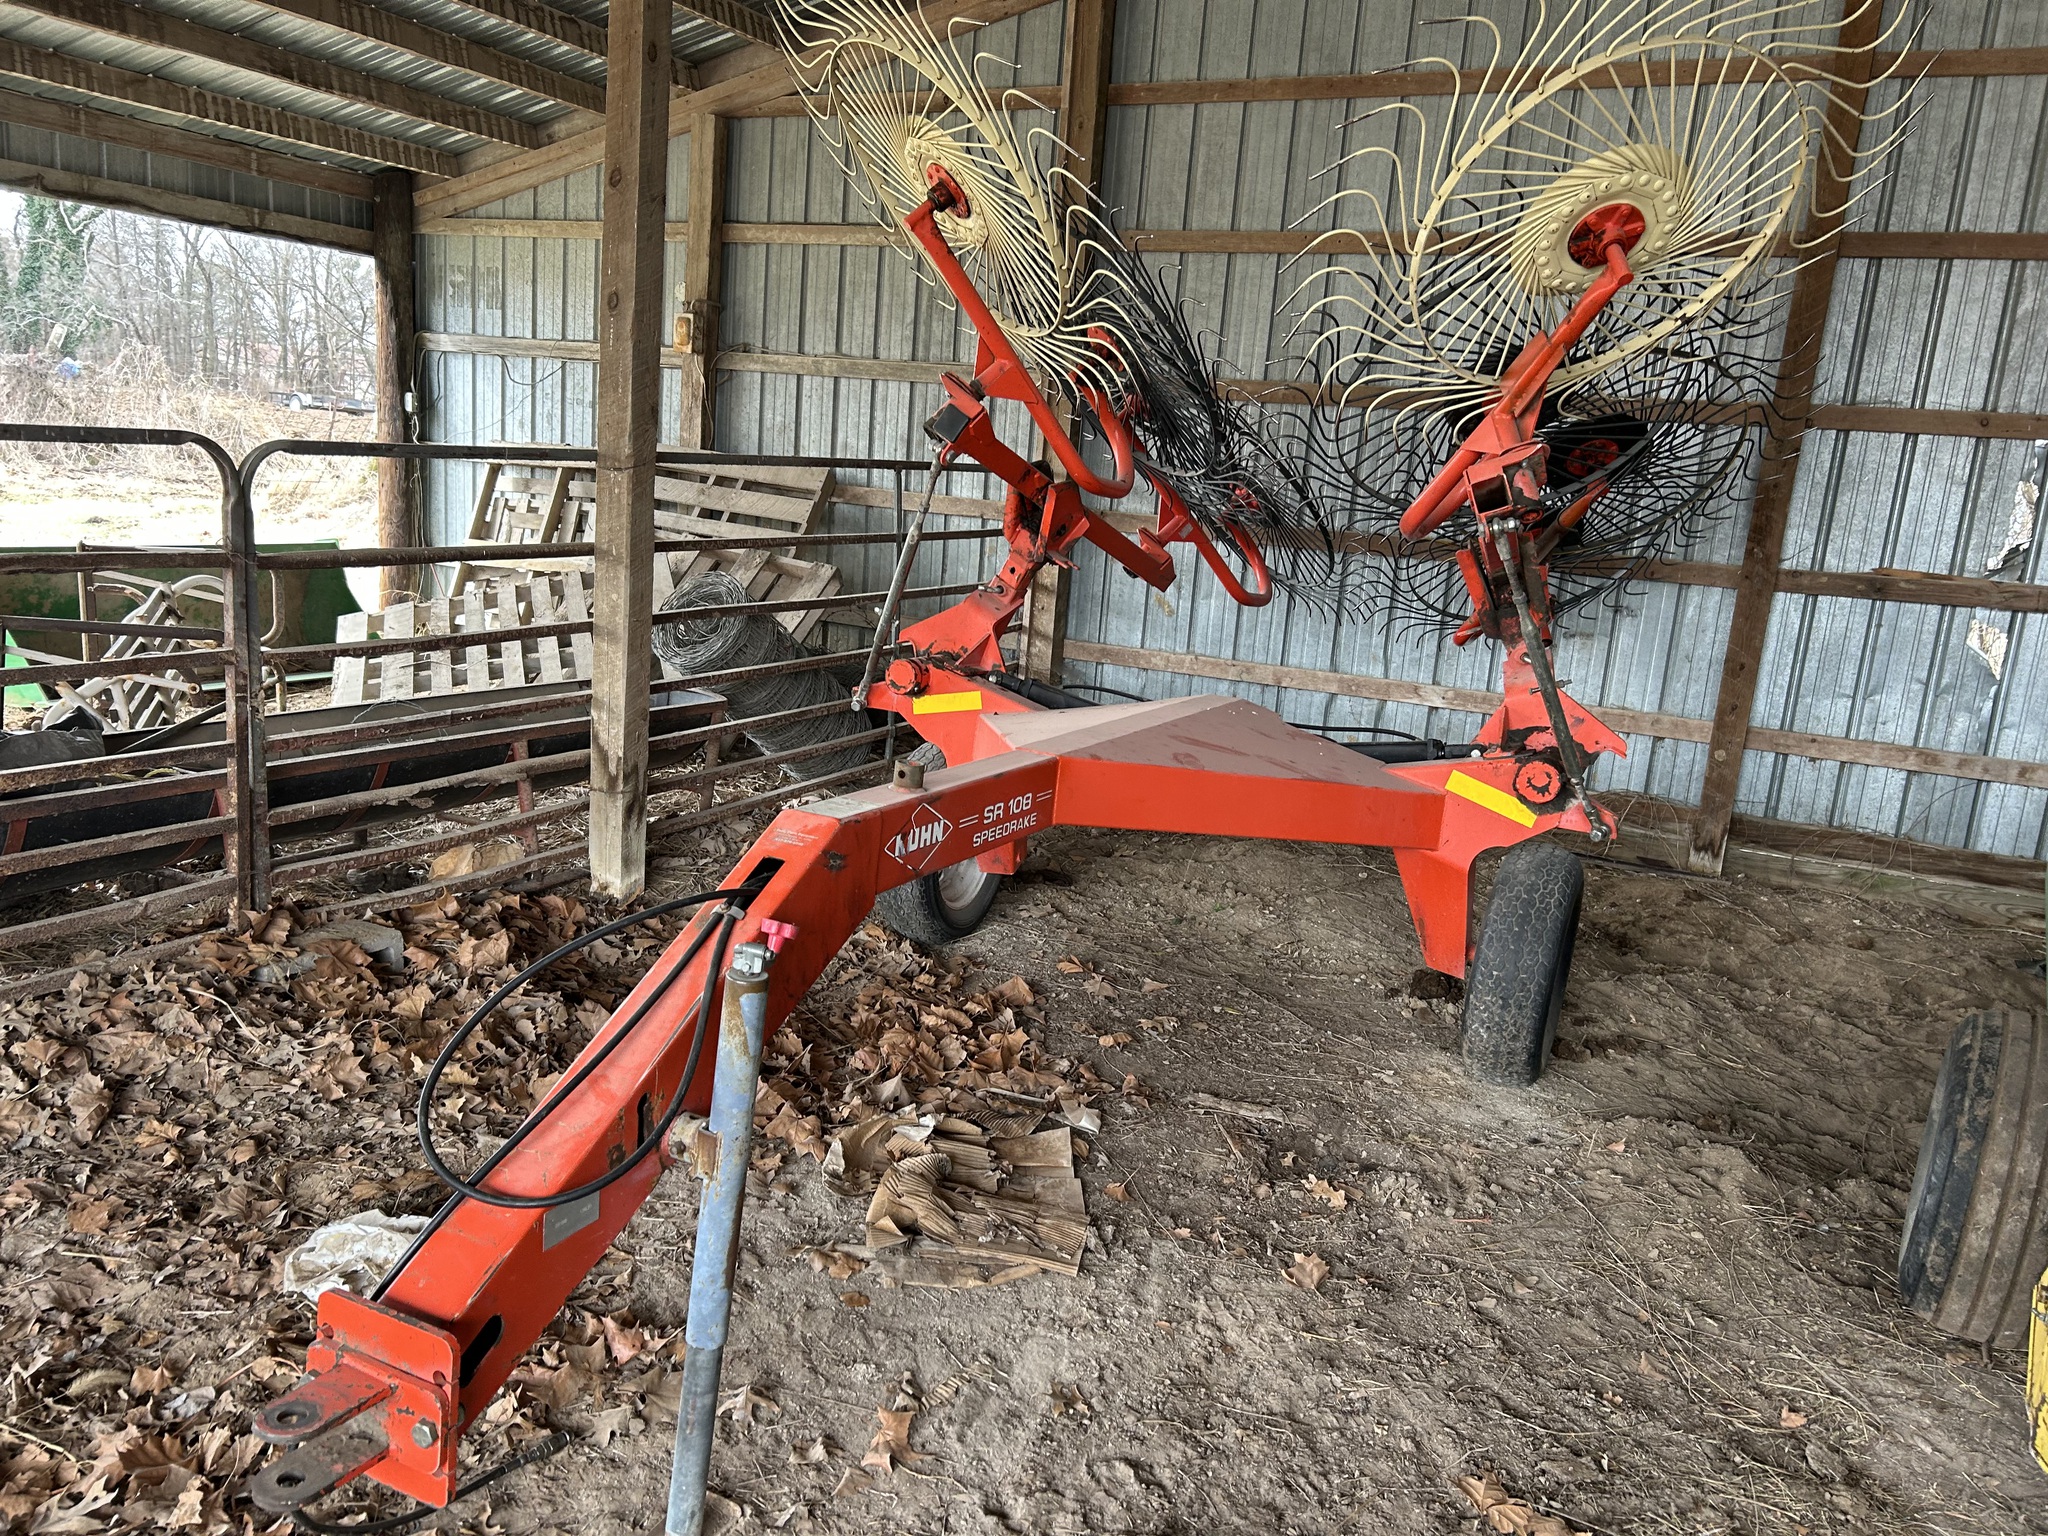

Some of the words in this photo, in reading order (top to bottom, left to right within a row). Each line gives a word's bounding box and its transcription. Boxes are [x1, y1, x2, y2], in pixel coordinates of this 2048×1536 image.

[983, 802, 1004, 824] SR
[1008, 793, 1032, 816] 108
[895, 819, 944, 857] KUHN
[973, 813, 1037, 847] SPEEDRAKE
